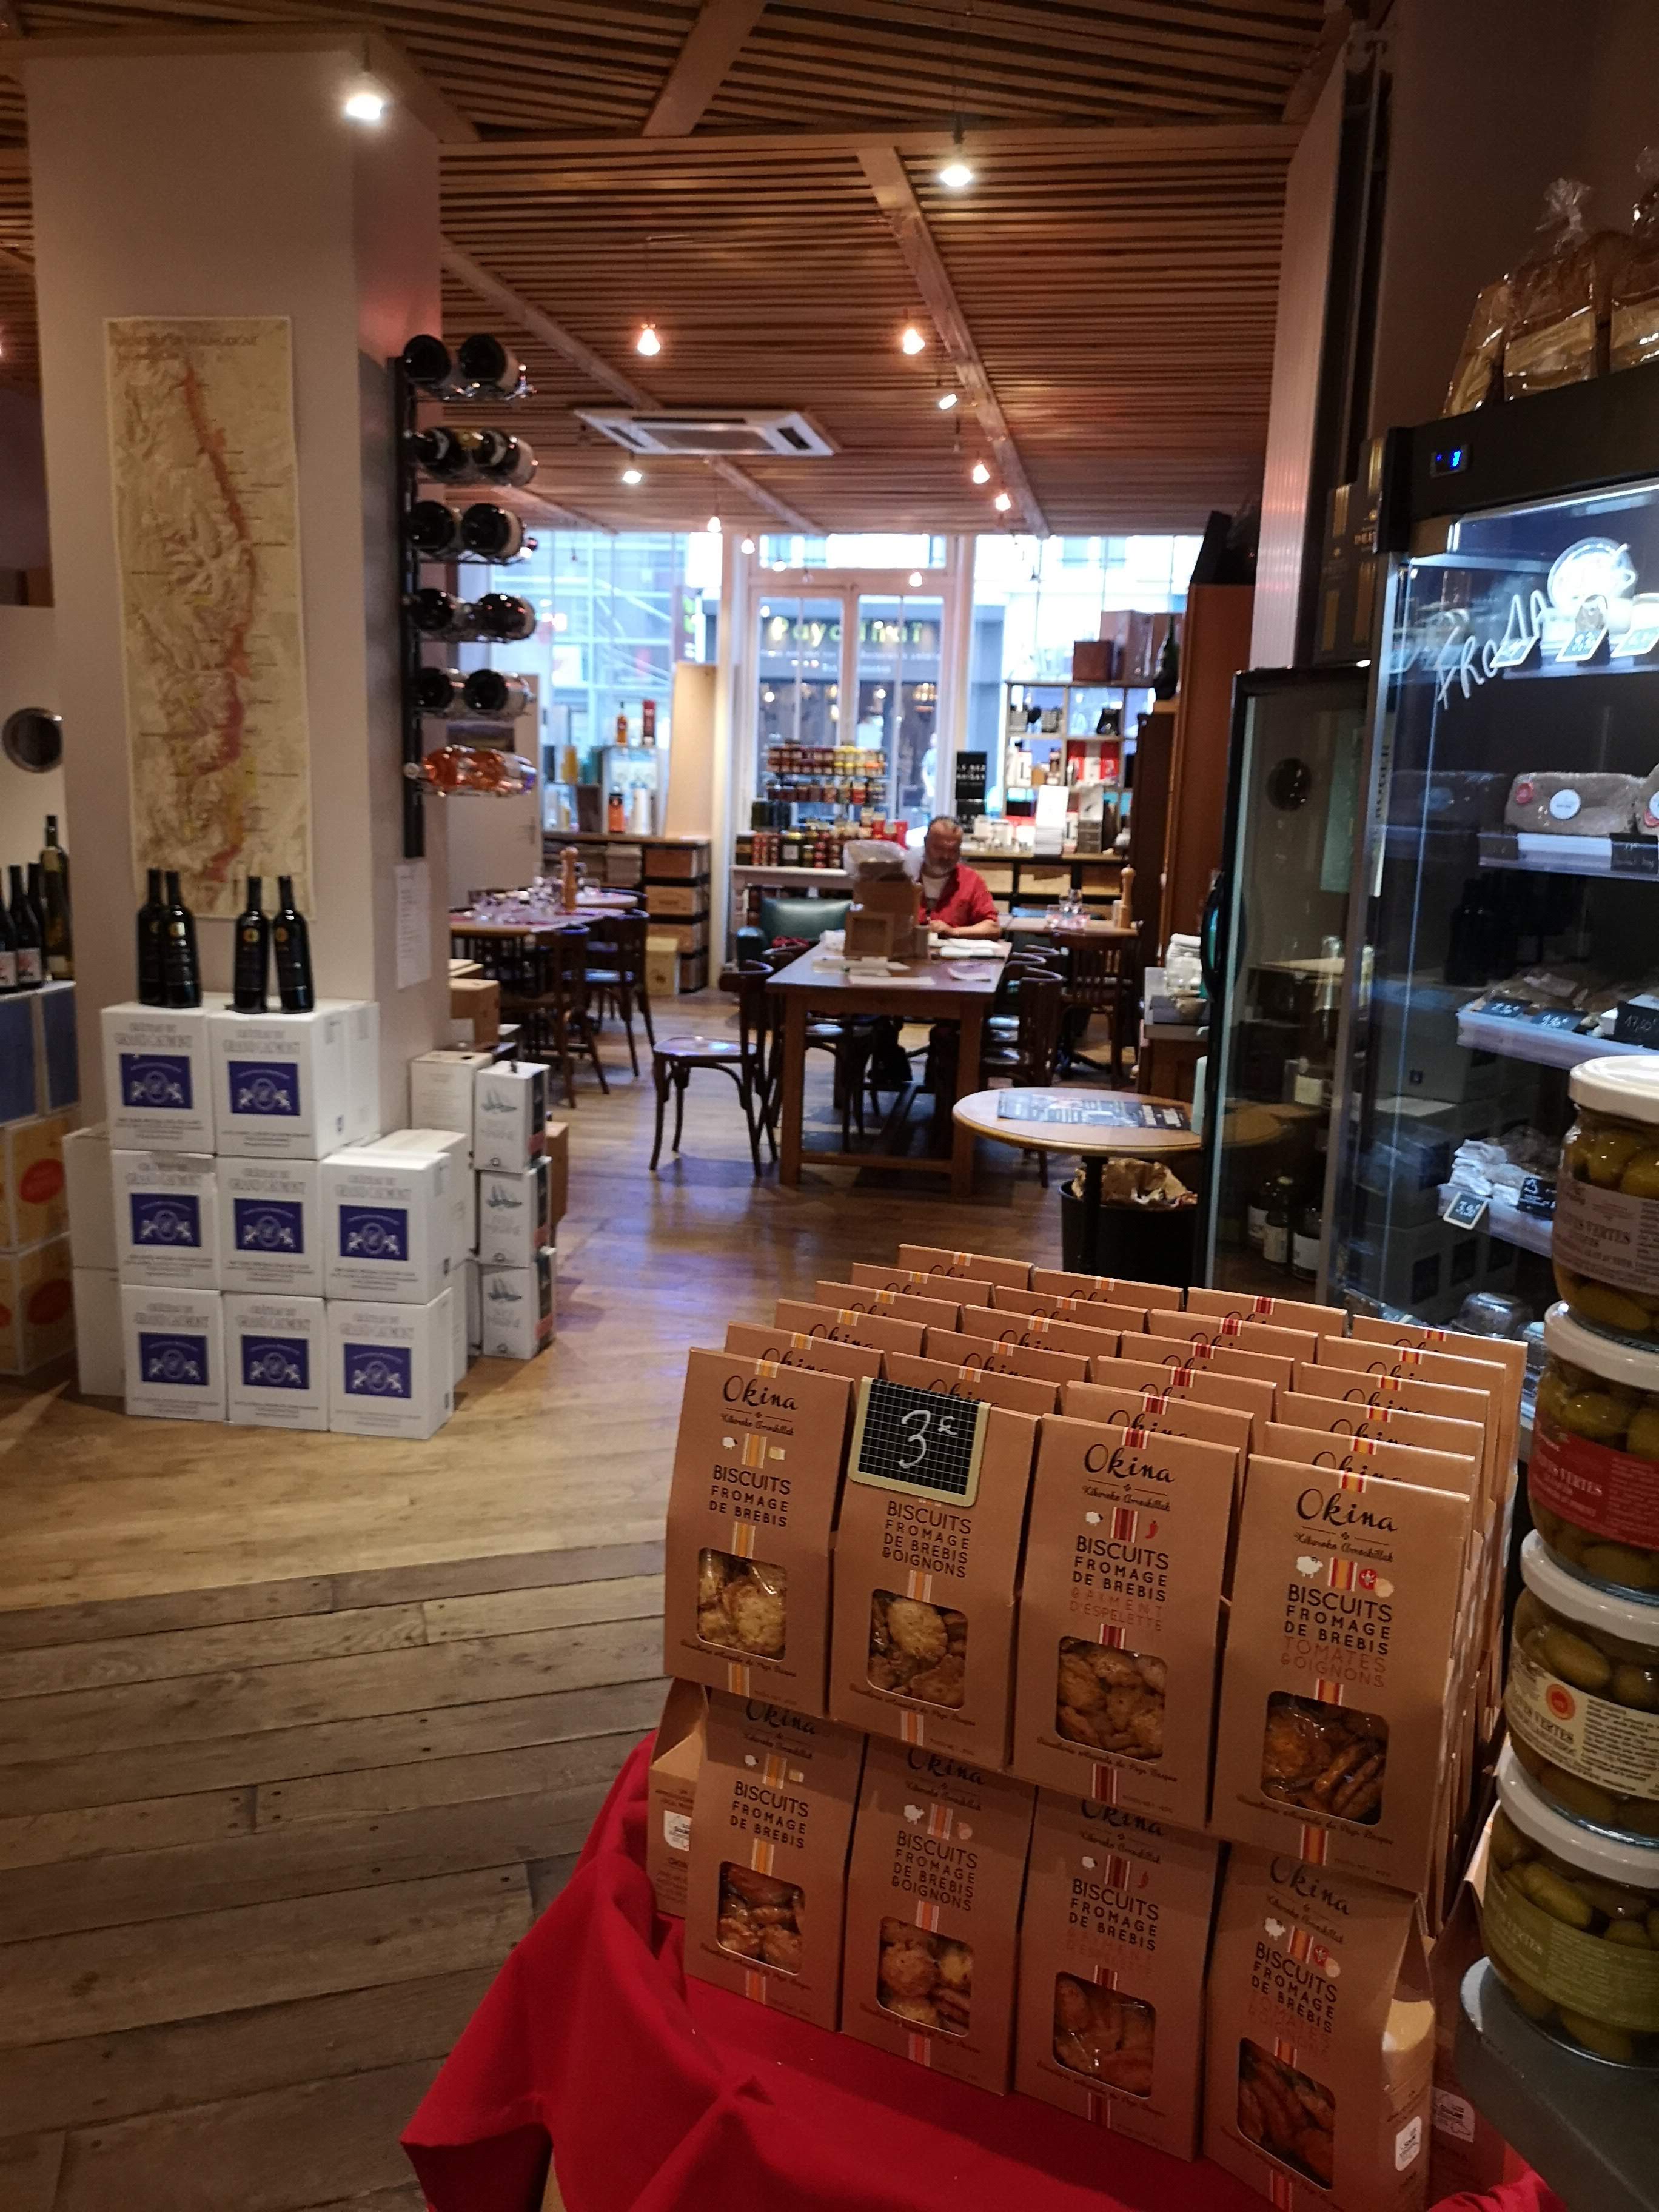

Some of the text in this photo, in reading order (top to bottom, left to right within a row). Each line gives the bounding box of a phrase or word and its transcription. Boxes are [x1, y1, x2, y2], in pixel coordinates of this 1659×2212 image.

[723, 1375, 799, 1410] Okina
[713, 1465, 791, 1495] BISCUITS
[1085, 1443, 1175, 1483] Okina
[709, 1501, 787, 1527] DE BREBIS
[711, 1485, 788, 1512] FROMAGE
[1297, 1488, 1398, 1532] Okina
[885, 1519, 970, 1549] FROMAGE
[887, 1501, 971, 1535] BISCUITS
[883, 1533, 968, 1563] DE BREBIS
[1076, 1535, 1168, 1570] BISCUITS
[1073, 1571, 1166, 1602] DE BREBIS
[1074, 1556, 1167, 1587] FROMAGE
[1289, 1584, 1393, 1623] BISCUITS
[1284, 1621, 1389, 1655] DE BREBIS
[1286, 1605, 1390, 1640] FROMAGE
[1284, 1637, 1387, 1673] TOMATES
[734, 1781, 809, 1818] BISCUITS
[730, 1815, 805, 1849] DE BREBIS
[732, 1801, 806, 1834] FROMAGE
[894, 1849, 975, 1883] FROMAGE
[897, 1830, 978, 1869] BISCUITS
[893, 1862, 974, 1897] DE BREBIS
[1070, 1897, 1157, 1937] FROMAGE
[1072, 1878, 1159, 1921] BISCUITS
[1068, 1911, 1089, 1928] DE
[1096, 1922, 1156, 1951] BREBIS
[1256, 1941, 1338, 2003] BISCUITS
[1250, 1975, 1332, 2033] DE BREBIS
[1253, 1961, 1335, 2020] FROMAGE
